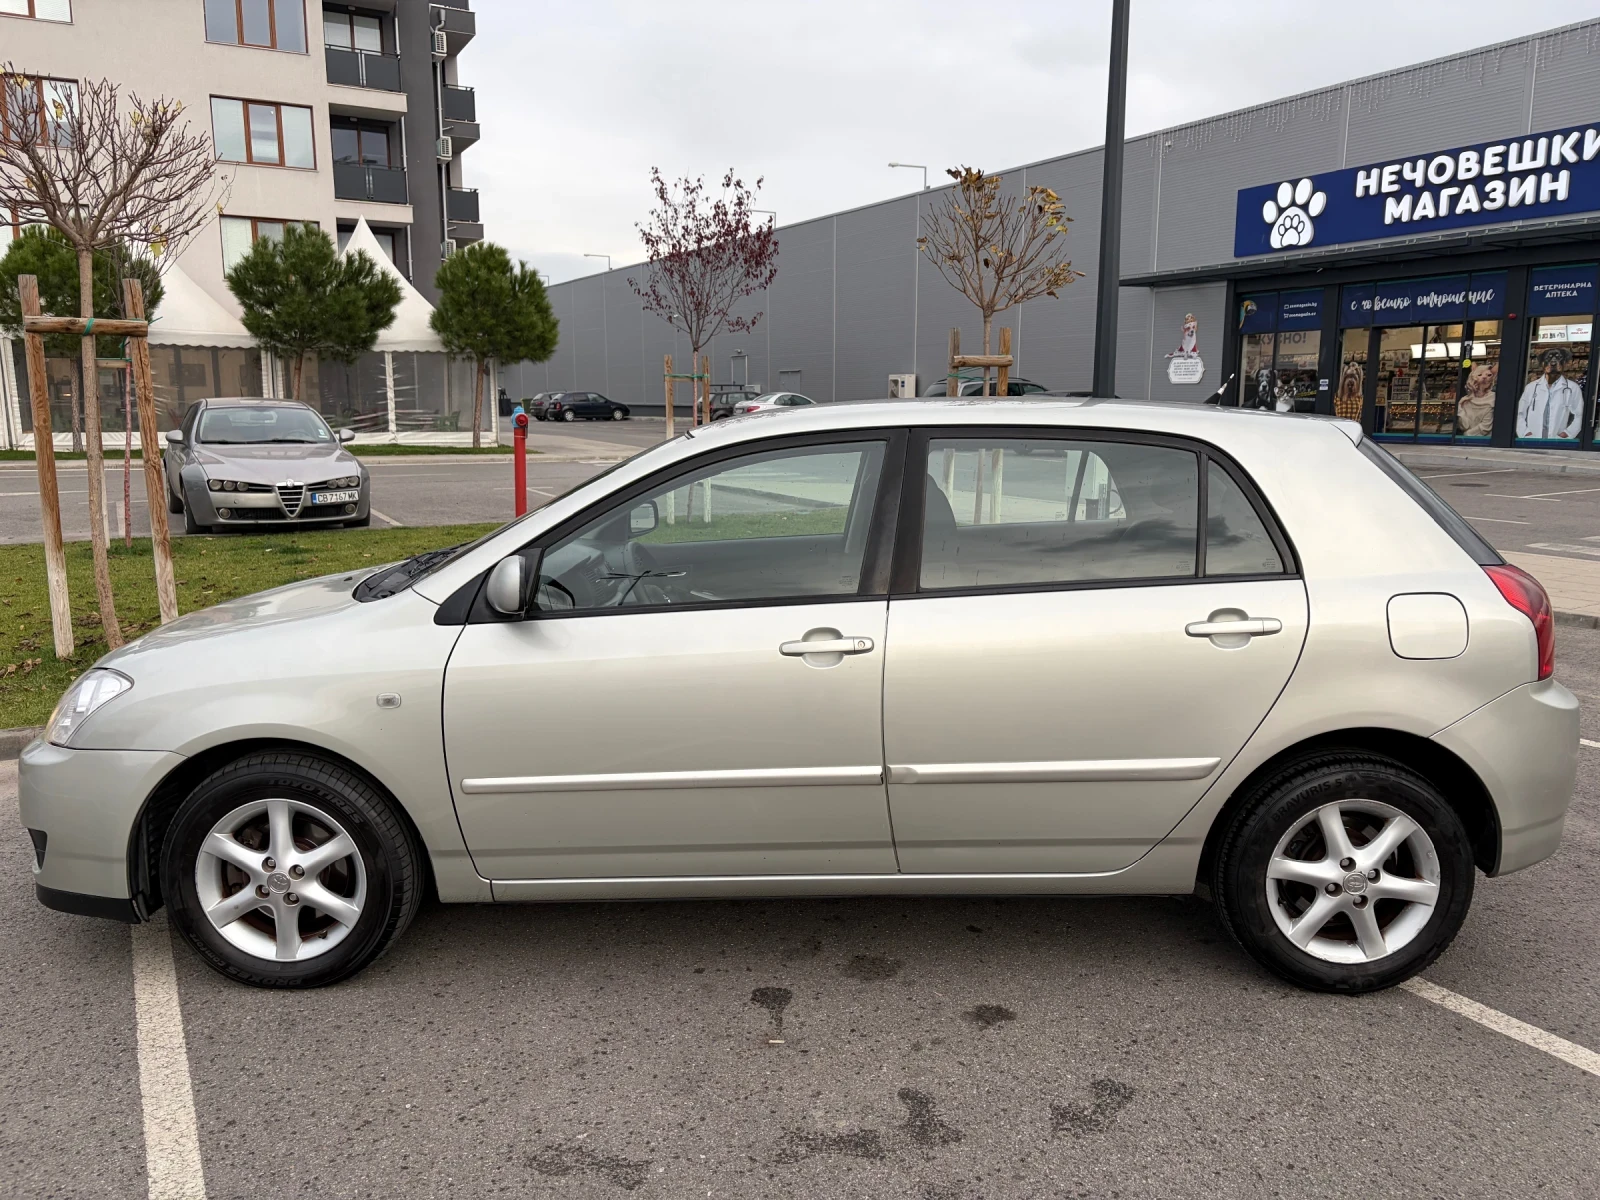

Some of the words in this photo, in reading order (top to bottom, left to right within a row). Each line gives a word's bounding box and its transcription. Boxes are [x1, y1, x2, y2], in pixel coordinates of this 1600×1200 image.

[1355, 128, 1600, 197] НЕЧОВЕШКИ
[1384, 169, 1571, 225] МАГАЗИН
[1533, 282, 1592, 291] ВЕТЕРИНАРНА
[1545, 290, 1578, 298] АПТЕКА
[329, 492, 347, 502] 7167
[268, 778, 313, 792] TOYO
[315, 788, 365, 824] TIRES
[1271, 780, 1332, 823] BRAVURIS
[226, 966, 303, 986] PROXES
